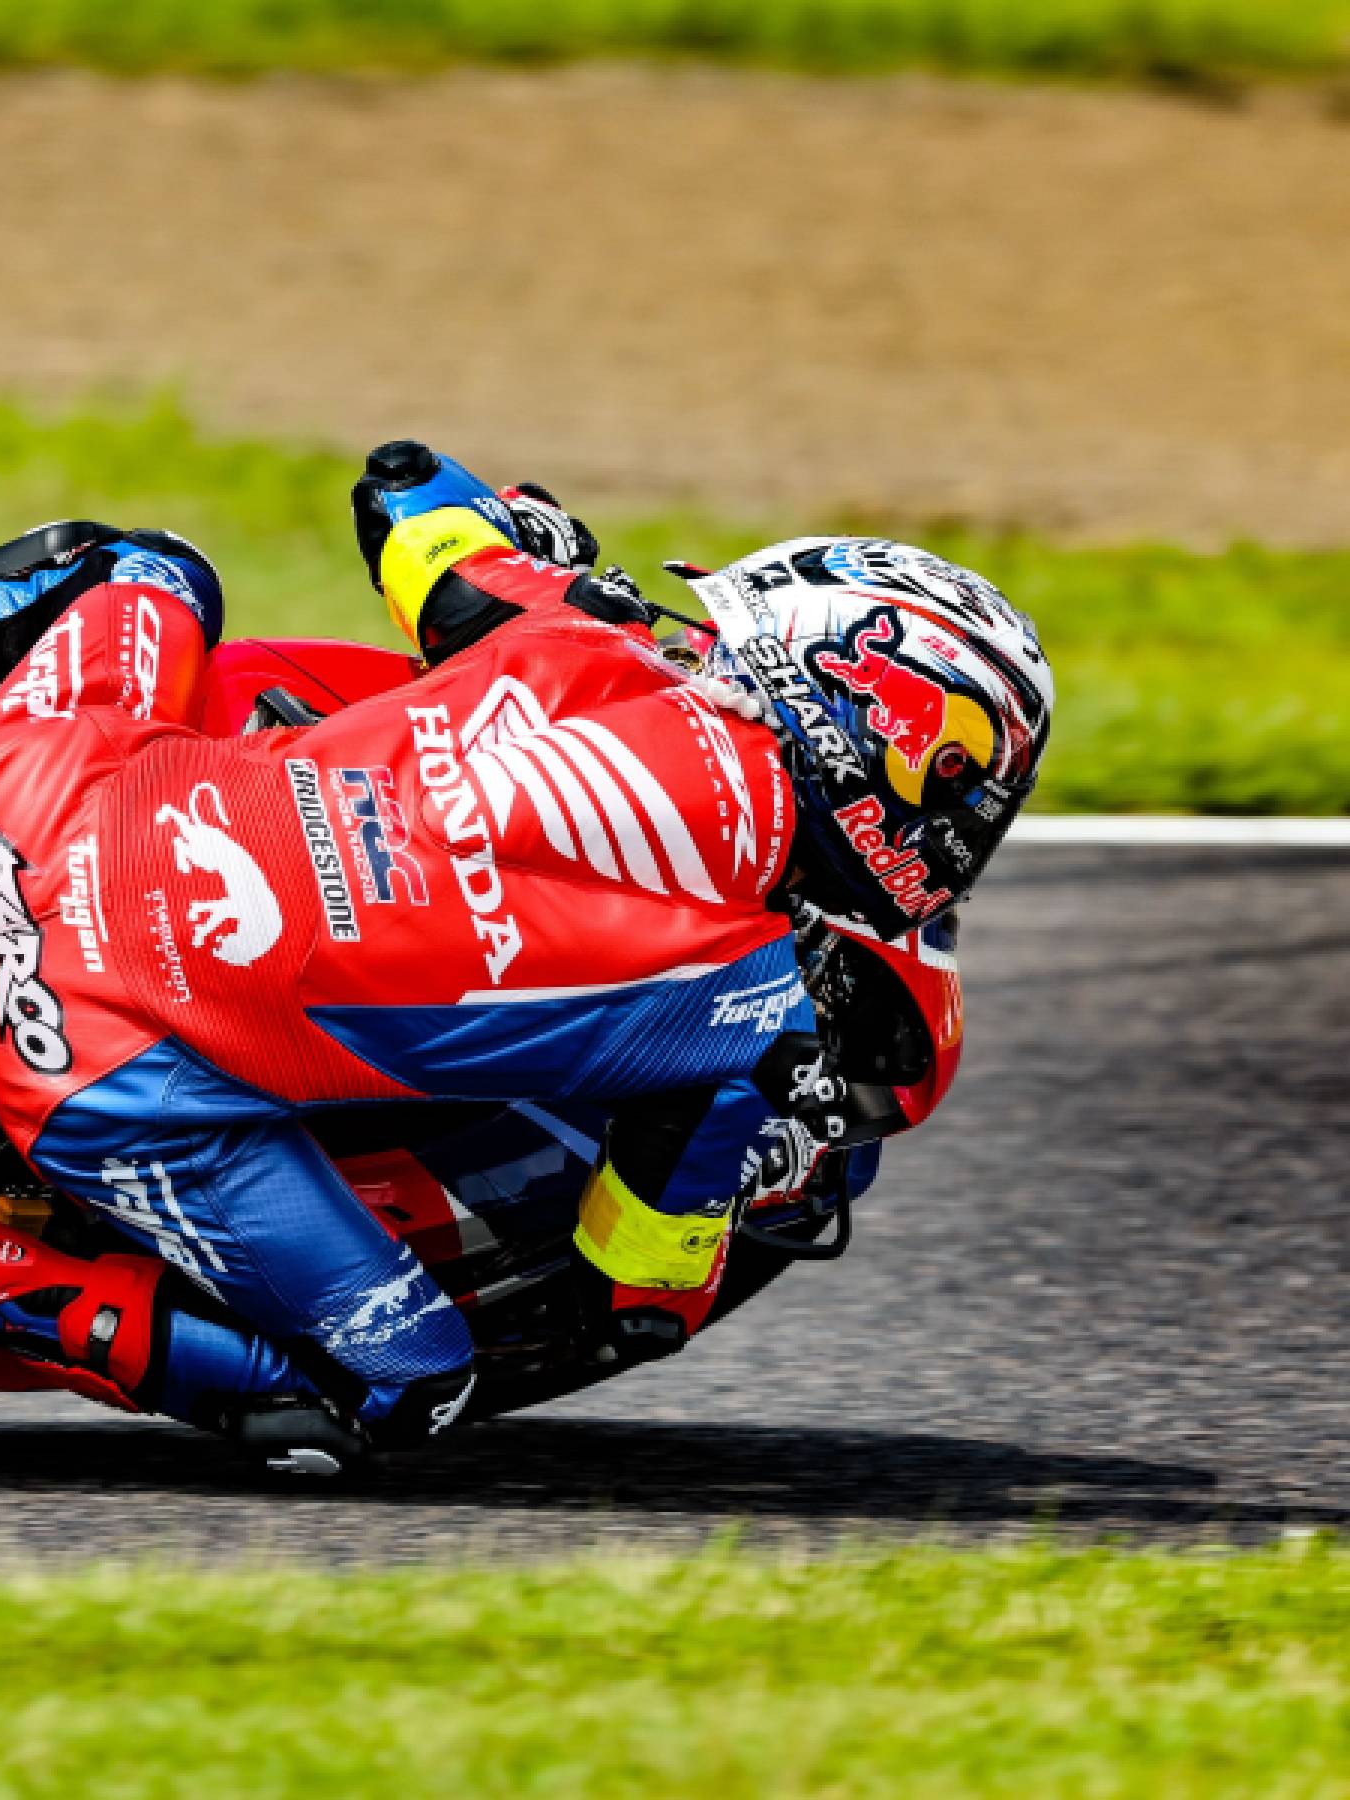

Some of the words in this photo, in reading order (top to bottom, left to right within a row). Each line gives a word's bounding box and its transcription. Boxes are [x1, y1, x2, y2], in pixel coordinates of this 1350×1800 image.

[746, 634, 868, 783] SHARK
[287, 760, 358, 941] BRIDGESTONE
[341, 766, 430, 906] HRC
[407, 705, 523, 985] HONDA
